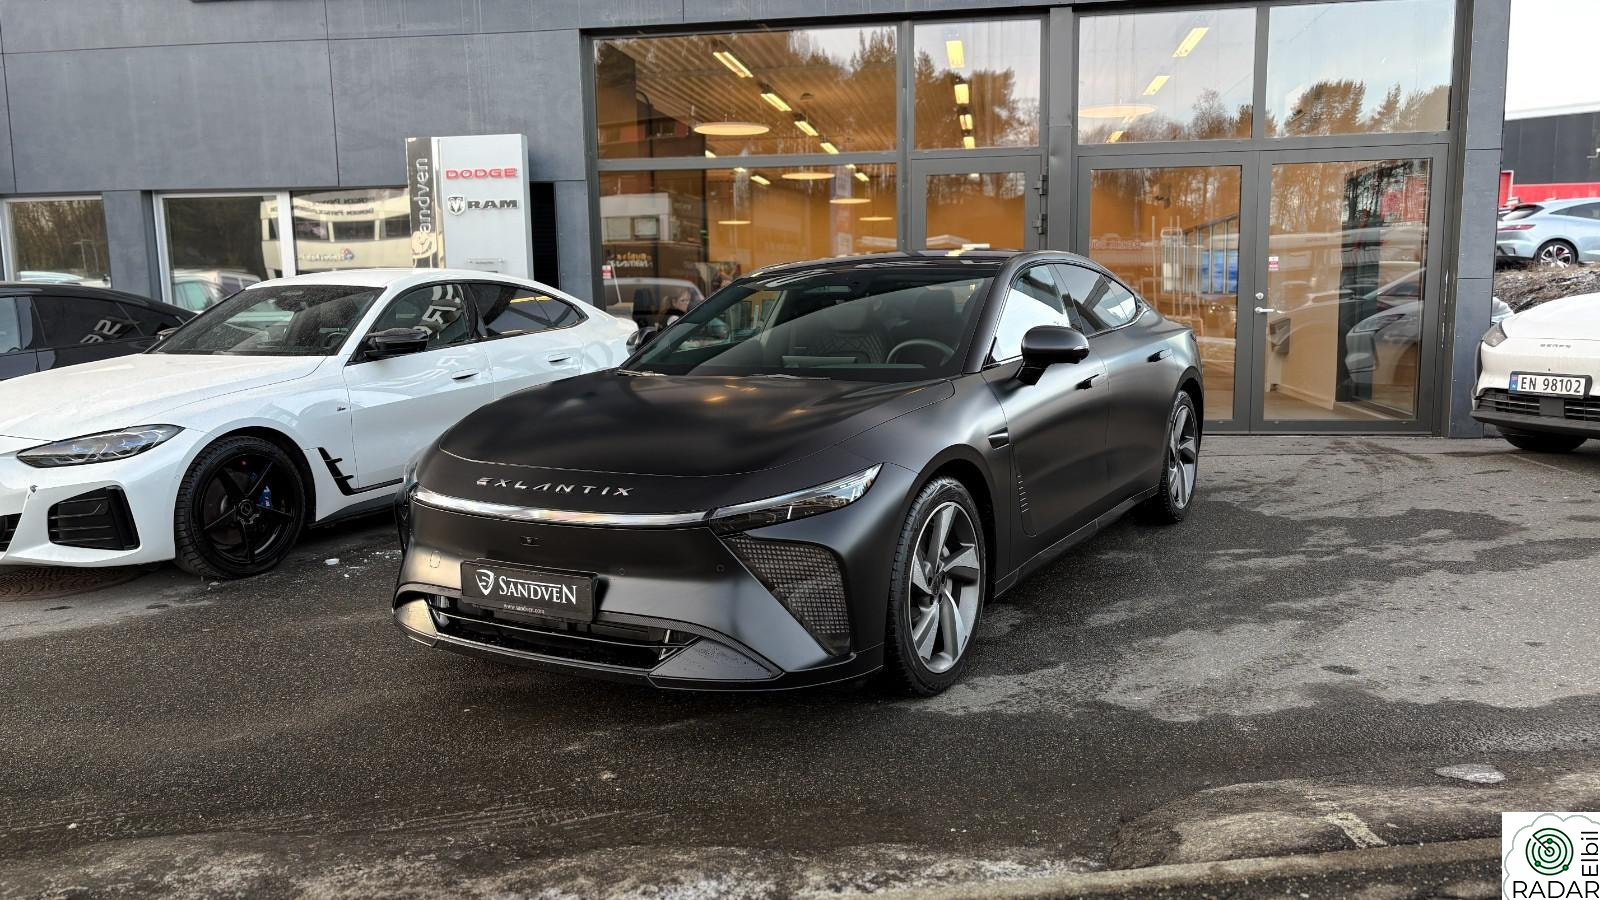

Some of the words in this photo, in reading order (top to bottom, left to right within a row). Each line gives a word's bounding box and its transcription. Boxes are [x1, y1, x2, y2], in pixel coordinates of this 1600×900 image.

[445, 167, 518, 180] DODGE
[467, 199, 518, 210] RAM
[1520, 376, 1537, 391] EN
[1542, 378, 1581, 393] 98102
[476, 477, 634, 497] EXLANTIX
